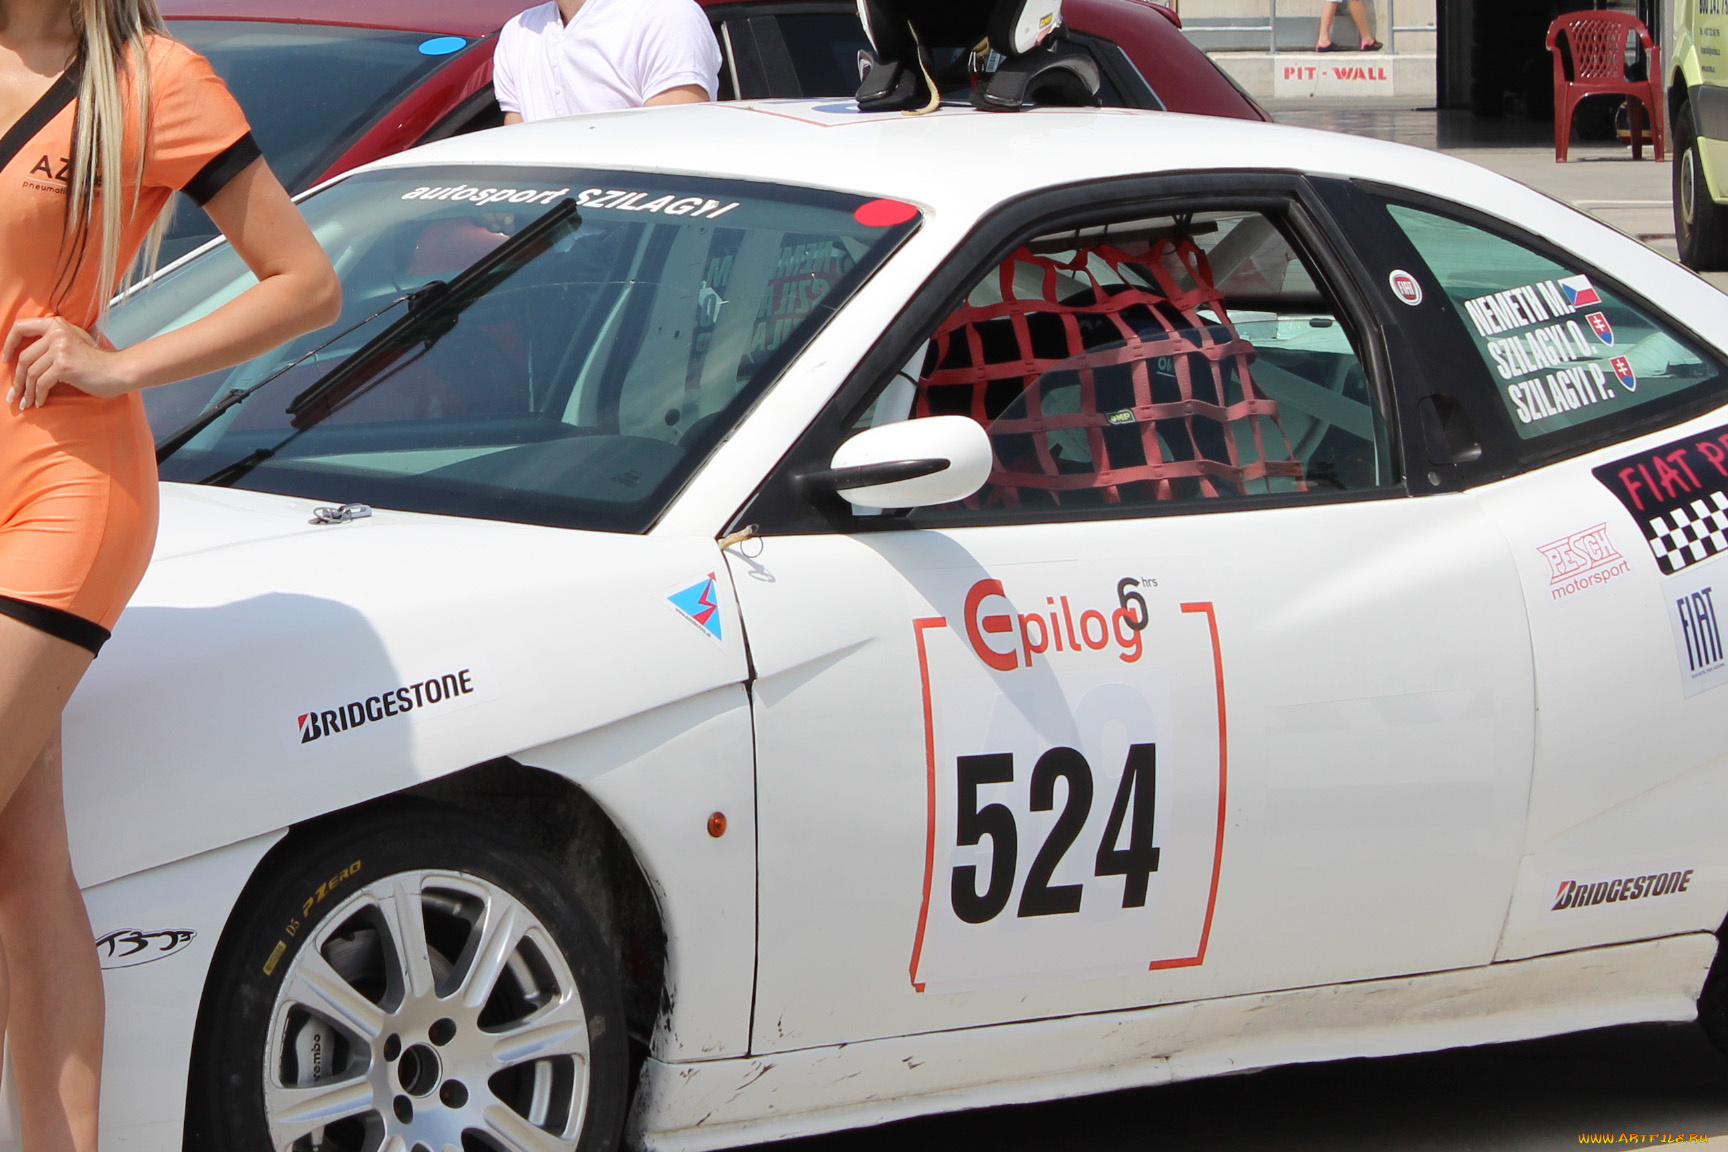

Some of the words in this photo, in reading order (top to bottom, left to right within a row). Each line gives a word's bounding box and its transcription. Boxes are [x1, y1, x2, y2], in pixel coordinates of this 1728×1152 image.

[1283, 66, 1317, 81] PIT
[1332, 66, 1387, 81] WALL
[401, 184, 570, 207] autosport
[573, 188, 741, 219] SZILAGYI
[1464, 284, 1549, 338] NEMETH
[1536, 279, 1576, 317] M.
[1487, 324, 1574, 380] SZILAGYI
[1508, 367, 1597, 424] SZILAGYI
[1588, 362, 1616, 400] P.
[1618, 449, 1703, 511] FIAT
[1546, 528, 1616, 576] PESCH
[1551, 560, 1632, 601] motorsport
[964, 578, 1144, 672] Epilog
[1141, 576, 1159, 588] hrs
[1676, 586, 1724, 672] FIAT
[297, 668, 475, 744] BRIDGESTONE
[951, 743, 1161, 925] 524
[315, 859, 363, 904] ZERO
[1551, 869, 1695, 911] BRIDGESTONE
[311, 1033, 321, 1082] rembo
